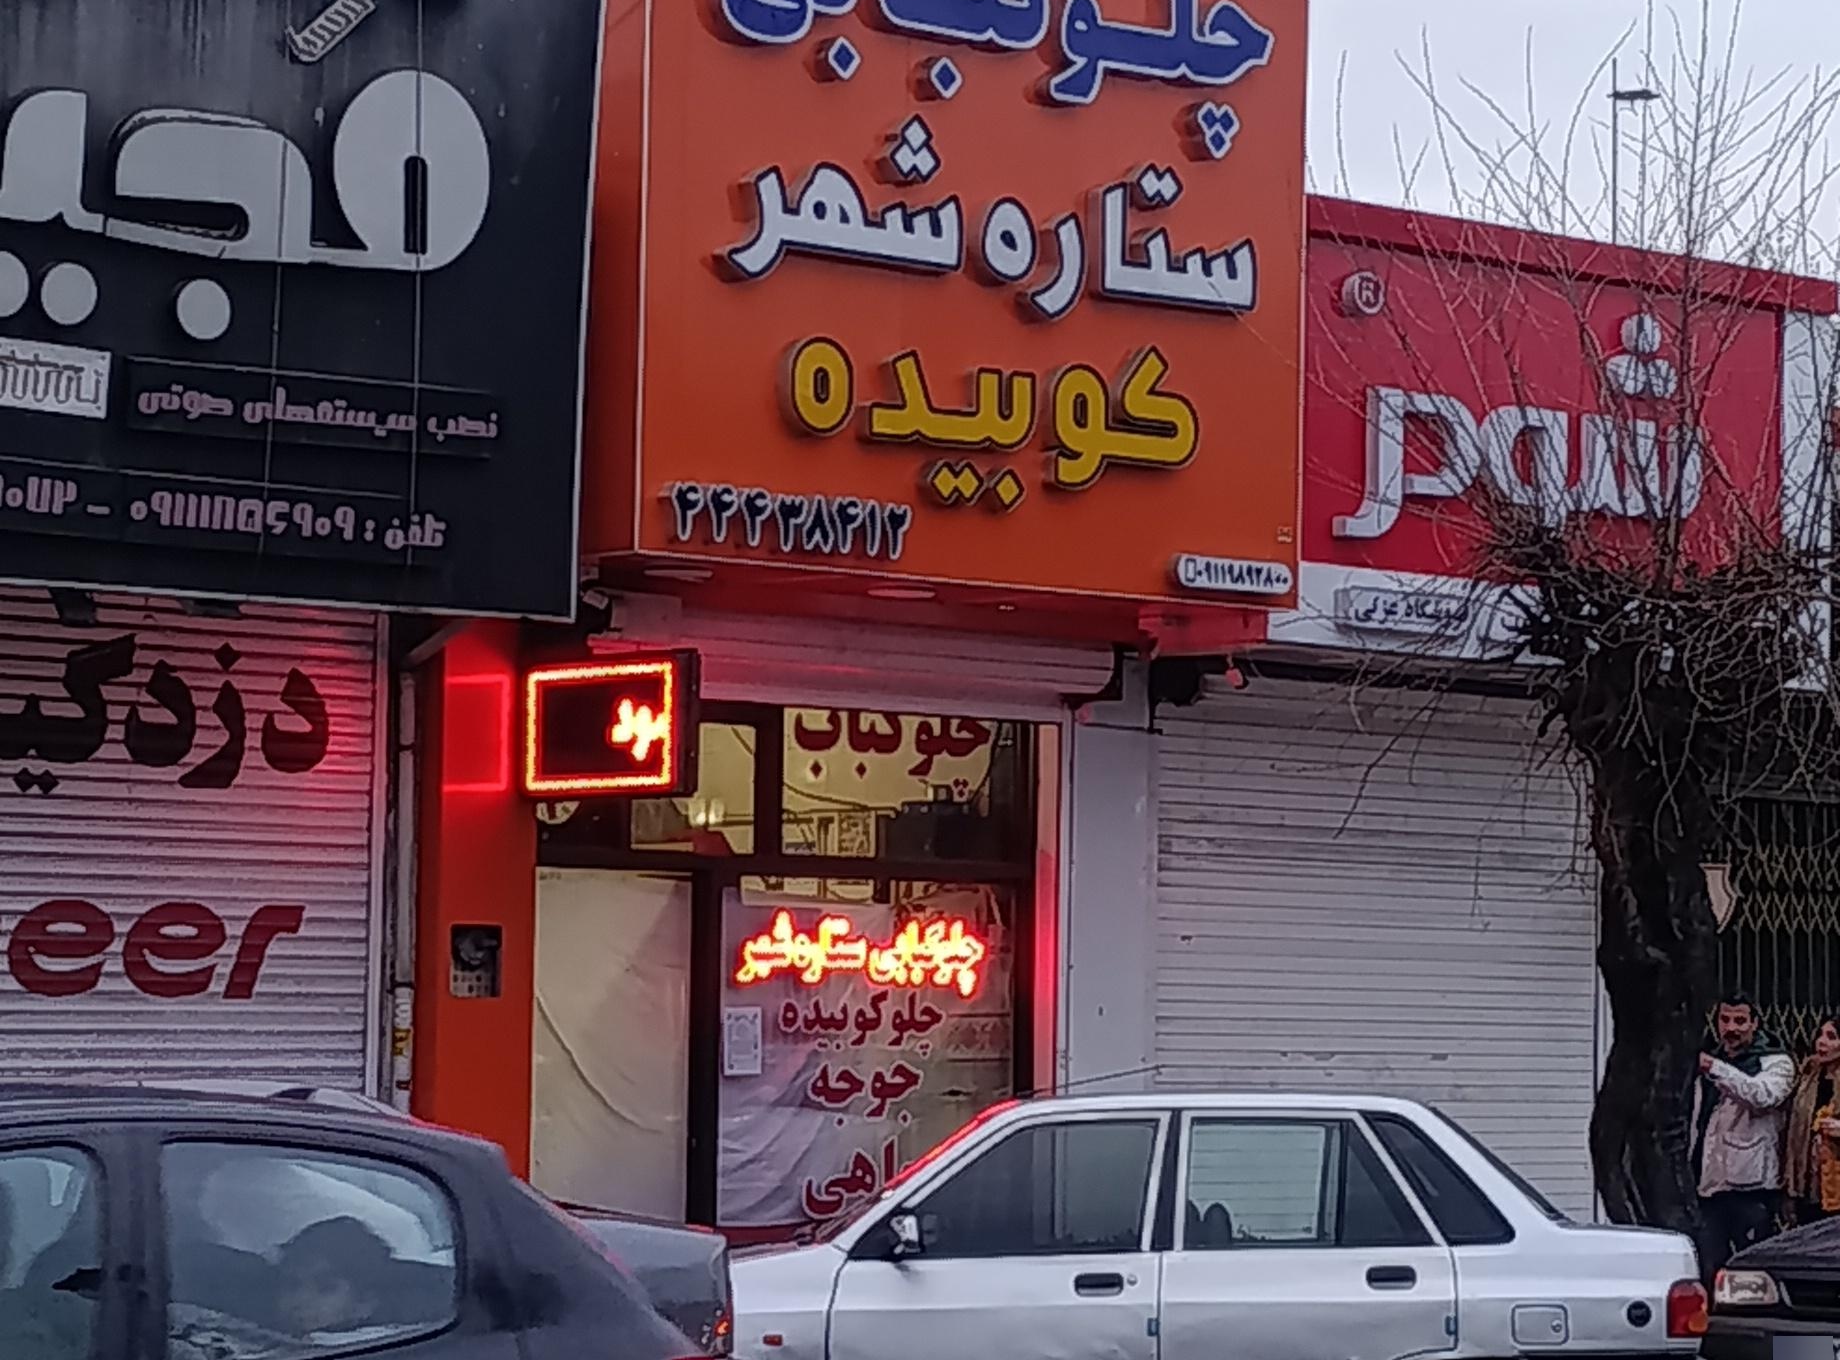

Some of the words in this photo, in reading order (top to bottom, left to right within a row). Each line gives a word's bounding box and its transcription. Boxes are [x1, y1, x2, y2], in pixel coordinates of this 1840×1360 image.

[727, 113, 965, 280] شهر
[981, 162, 1258, 322] ستاره
[137, 384, 234, 419] صوتی
[426, 412, 499, 442] نصب
[790, 335, 1200, 513] کوبیده
[671, 480, 913, 561] ۴۴۴۳۸۴۱۲
[808, 1061, 923, 1127] جوجه
[803, 1135, 913, 1219] اهی
